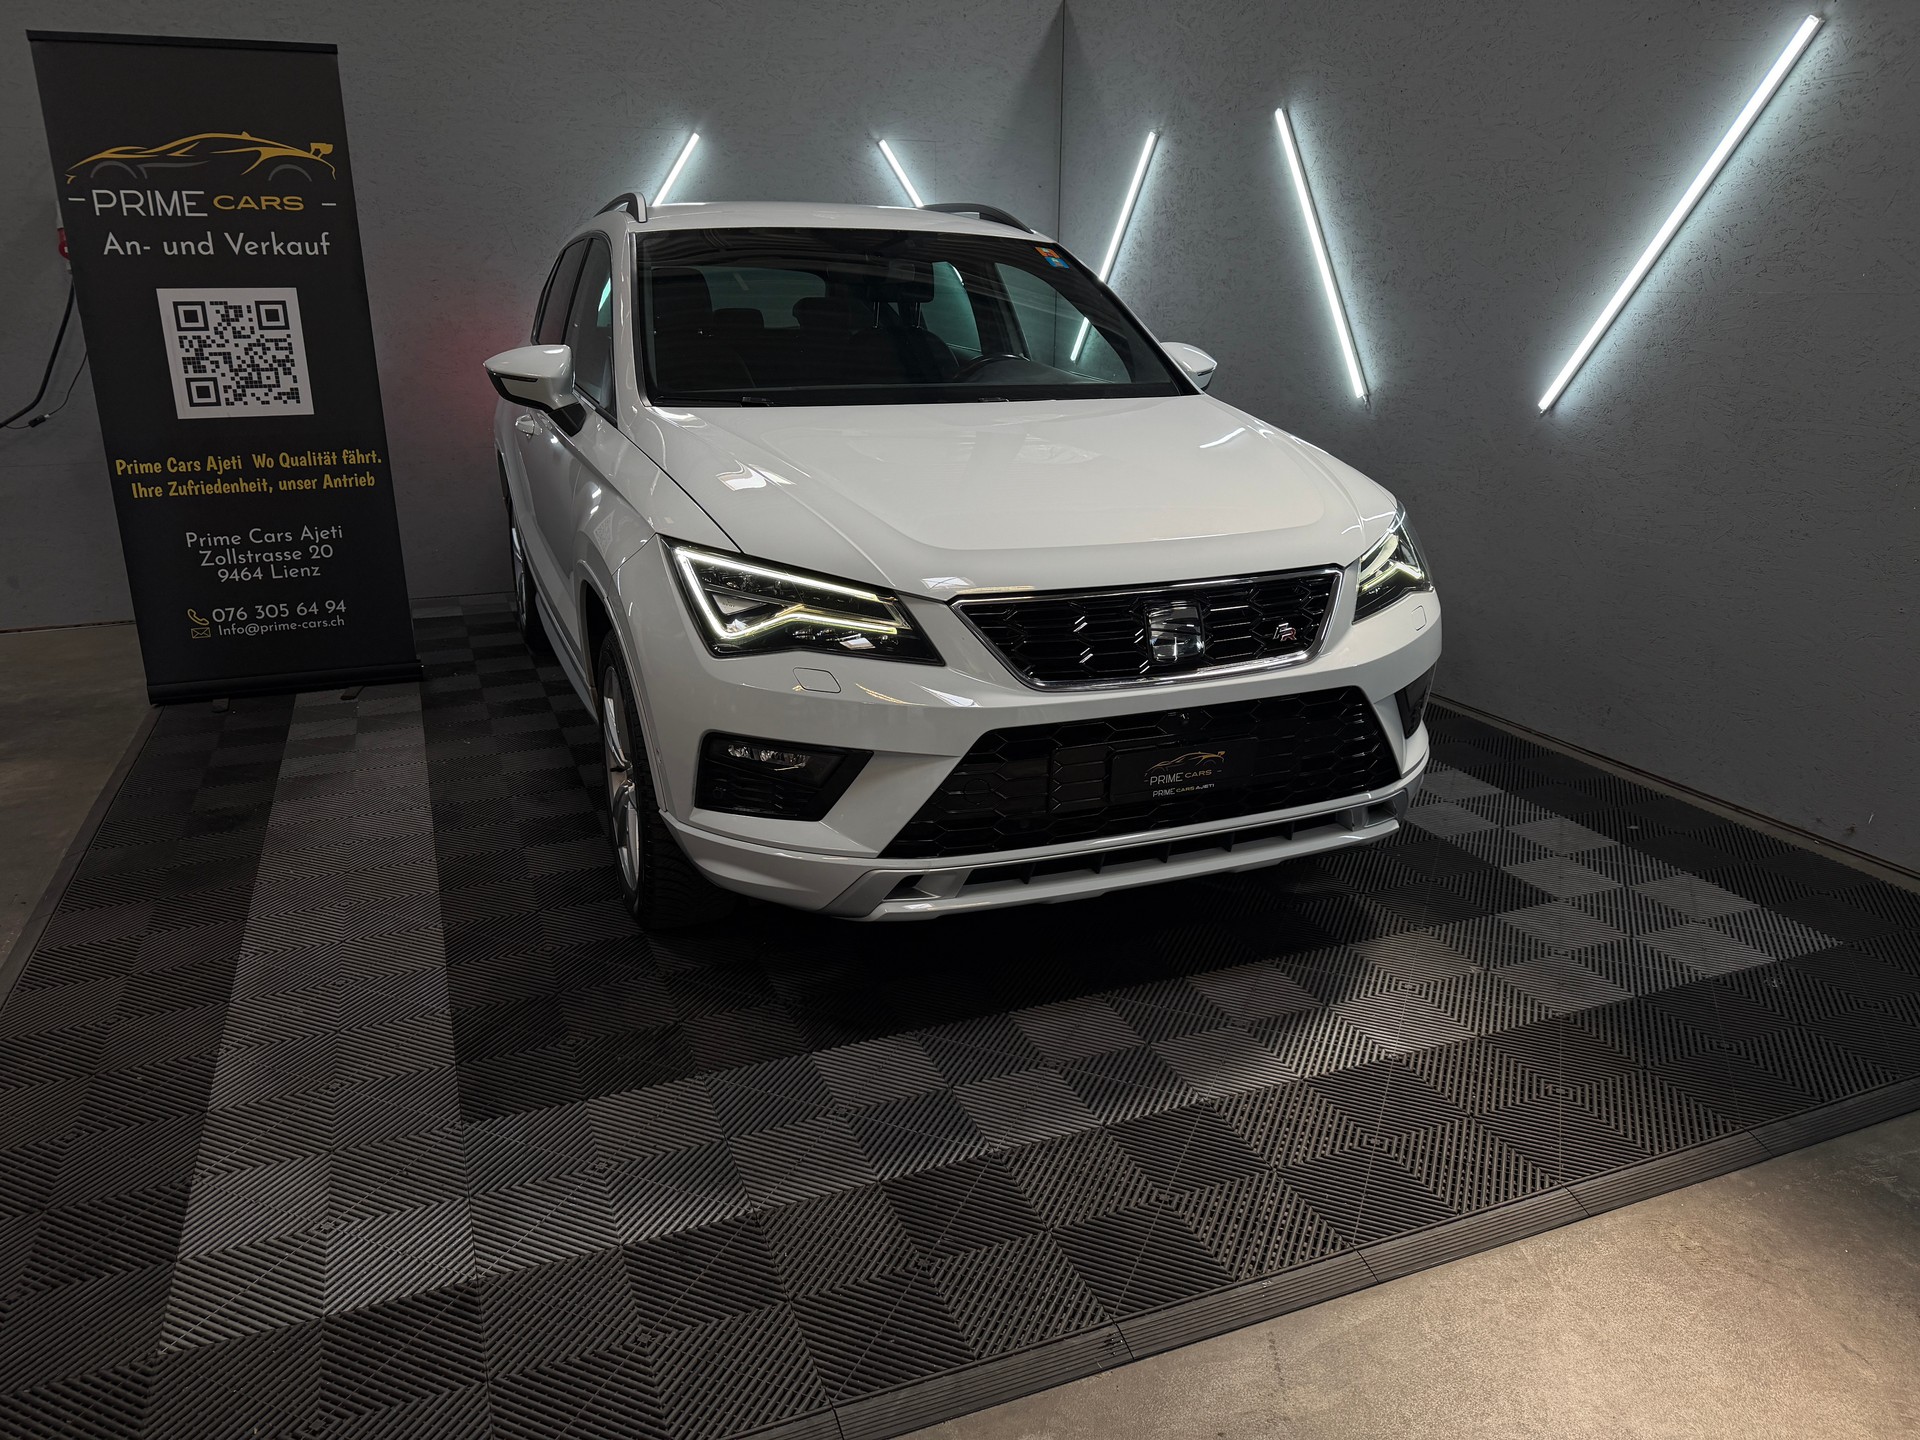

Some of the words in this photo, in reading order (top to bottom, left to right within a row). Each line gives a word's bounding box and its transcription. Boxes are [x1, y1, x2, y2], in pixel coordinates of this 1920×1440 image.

[91, 189, 208, 217] PRIME
[212, 194, 305, 211] CARS
[103, 231, 151, 256] An-
[162, 231, 215, 256] und
[223, 231, 331, 256] Verkauf
[115, 459, 162, 476] Prime
[166, 456, 202, 473] Cars
[206, 455, 243, 475] Ajeti
[251, 453, 275, 469] Wo
[279, 450, 338, 469] Qualität
[341, 448, 382, 465] fährt.
[131, 482, 163, 499] Ihre
[167, 477, 274, 497] Zufriedenheit,
[278, 478, 318, 490] unser
[323, 471, 376, 489] Antrieb
[185, 531, 242, 548] Prime
[249, 527, 293, 544] Cars
[300, 524, 344, 543] Ajeti
[199, 547, 303, 567] Zollstrasse
[308, 544, 334, 560] 20
[217, 567, 264, 583] 9464
[270, 563, 321, 579] Lienz
[211, 606, 248, 623] 076
[254, 603, 290, 619] 305
[296, 601, 320, 616] 64
[324, 599, 347, 614] 94
[218, 615, 346, 637] Info@prime-cars.ch
[1149, 771, 1184, 786] PRIME
[1184, 769, 1213, 779] CARS
[1152, 787, 1176, 798] PRIME
[1175, 785, 1195, 793] CARS
